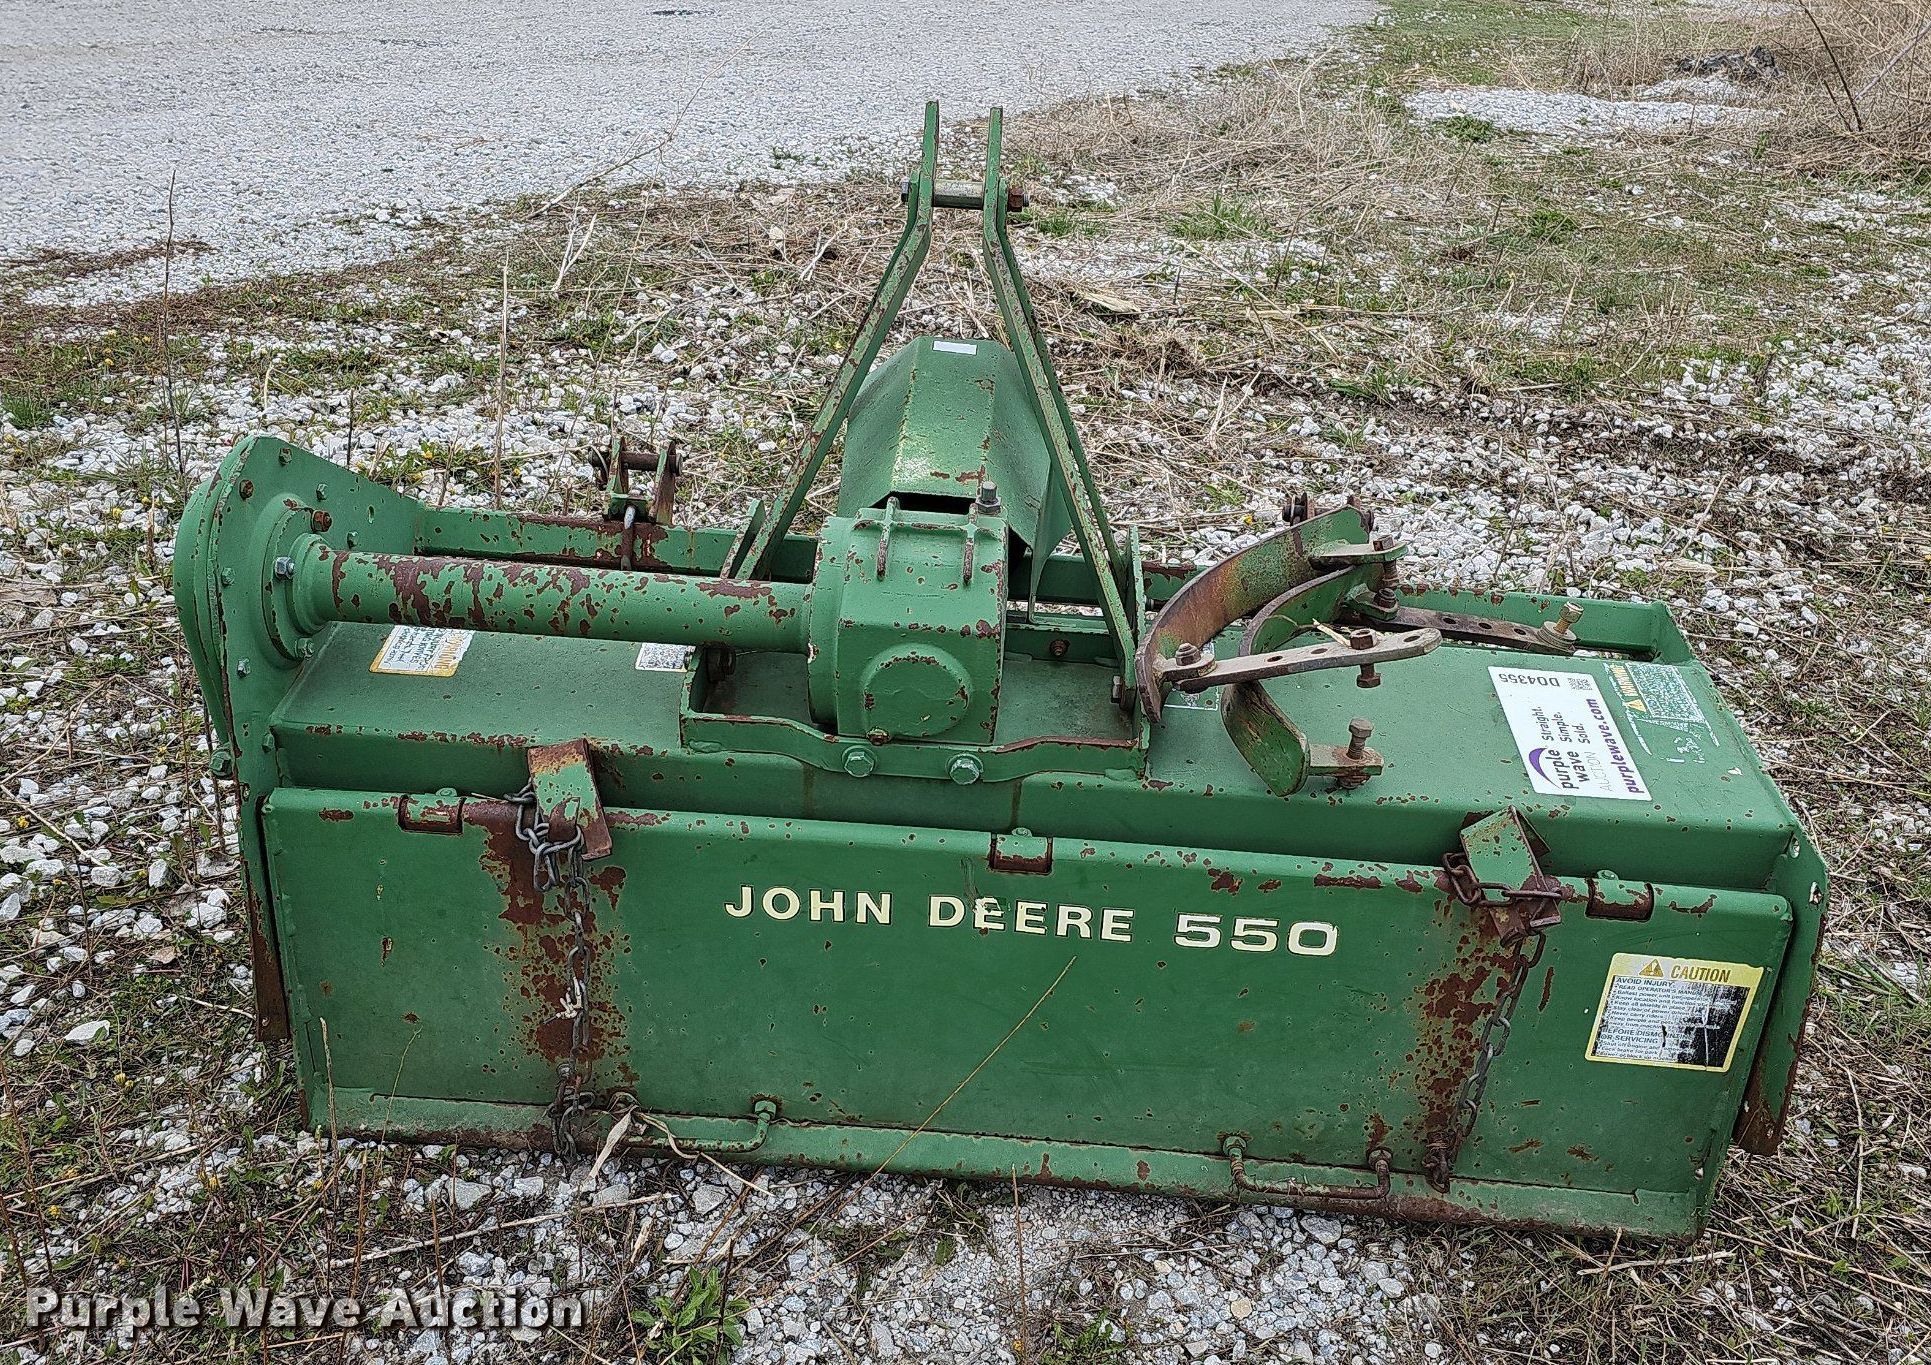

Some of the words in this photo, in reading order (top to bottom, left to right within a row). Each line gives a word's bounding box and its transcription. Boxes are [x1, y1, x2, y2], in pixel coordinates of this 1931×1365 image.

[1532, 706, 1554, 741] Straight.
[1551, 712, 1572, 742] Simple.
[1572, 723, 1590, 744] Sold.
[1586, 699, 1645, 793] purplewave.com
[1545, 749, 1579, 790] purple
[1571, 751, 1590, 782] wave
[1586, 751, 1613, 792] AUCTION
[724, 884, 893, 926] JOHN
[928, 895, 1135, 943] DEERE
[1173, 911, 1339, 956] 550
[1670, 965, 1731, 983] CAUTION
[1614, 1034, 1659, 1044] SERVICING
